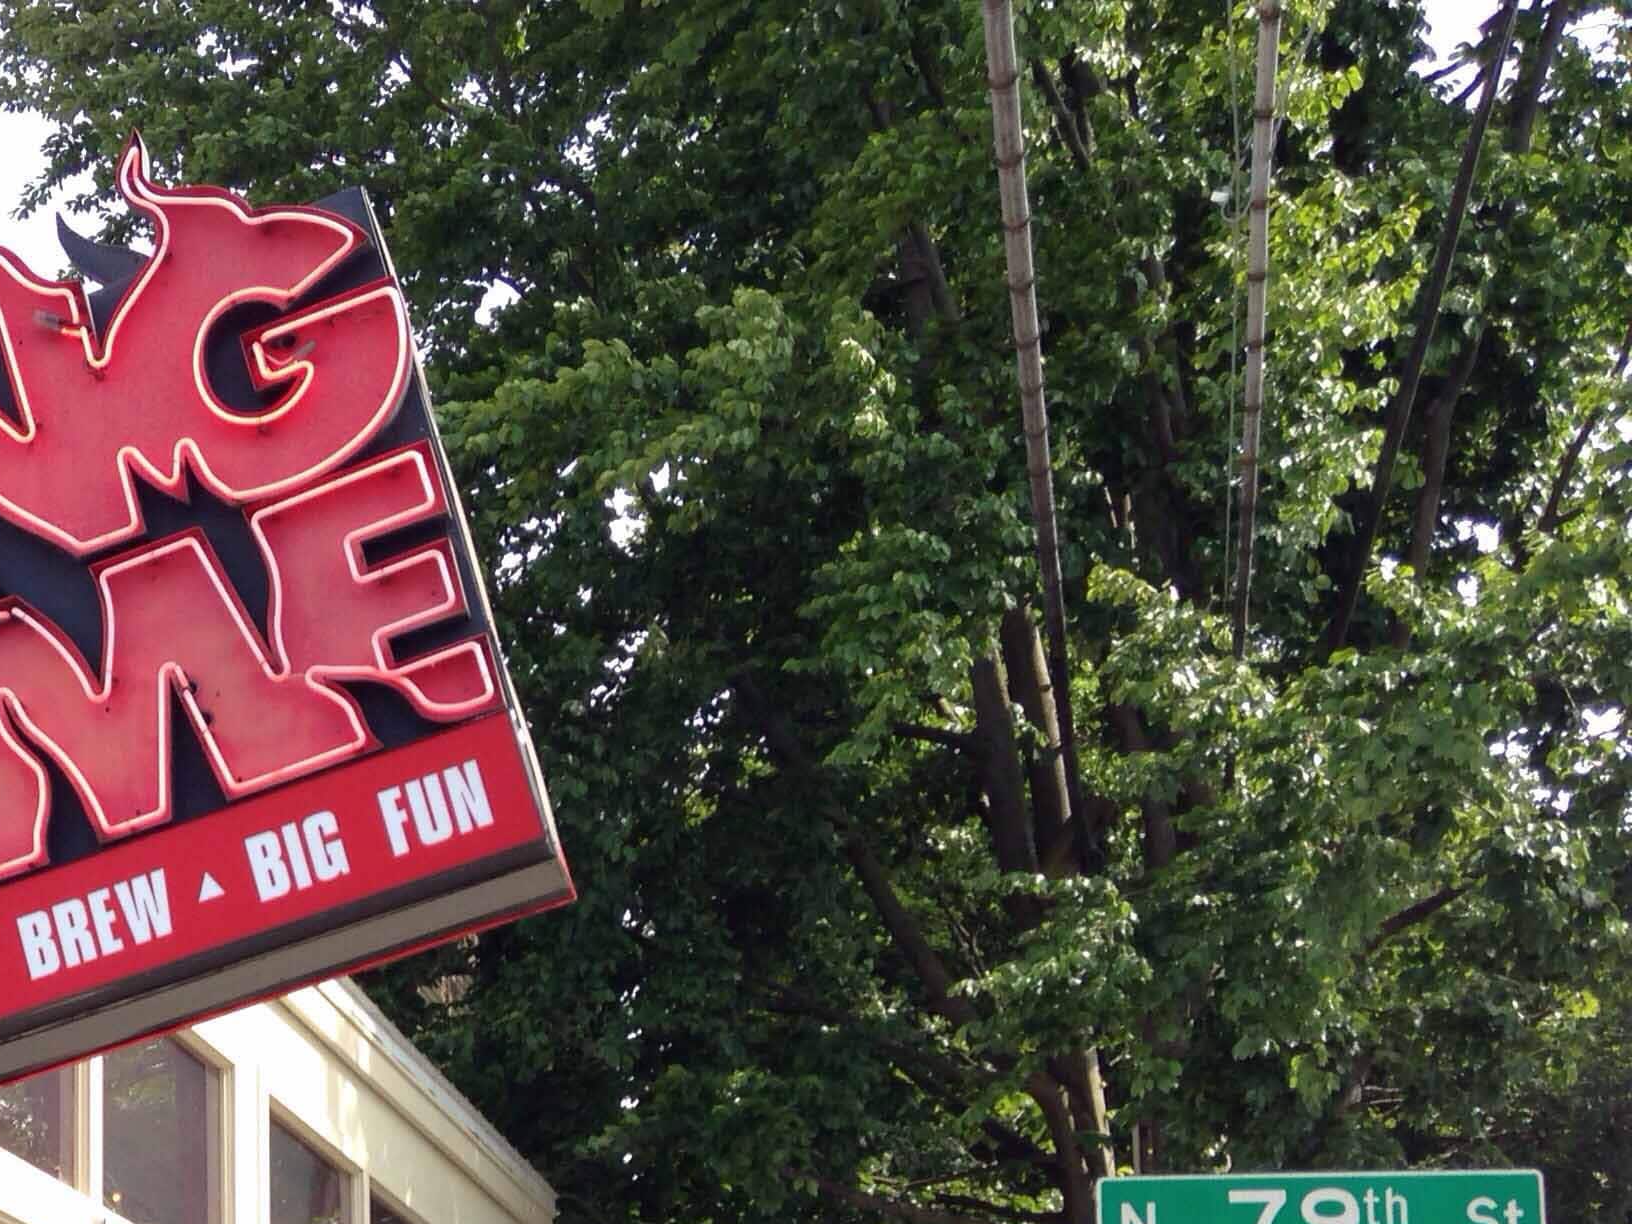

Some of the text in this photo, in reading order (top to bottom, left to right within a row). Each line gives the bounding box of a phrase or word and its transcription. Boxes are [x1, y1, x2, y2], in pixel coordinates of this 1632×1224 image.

[16, 867, 175, 981] BREW
[243, 809, 352, 903] BIG
[375, 758, 496, 858] FUN
